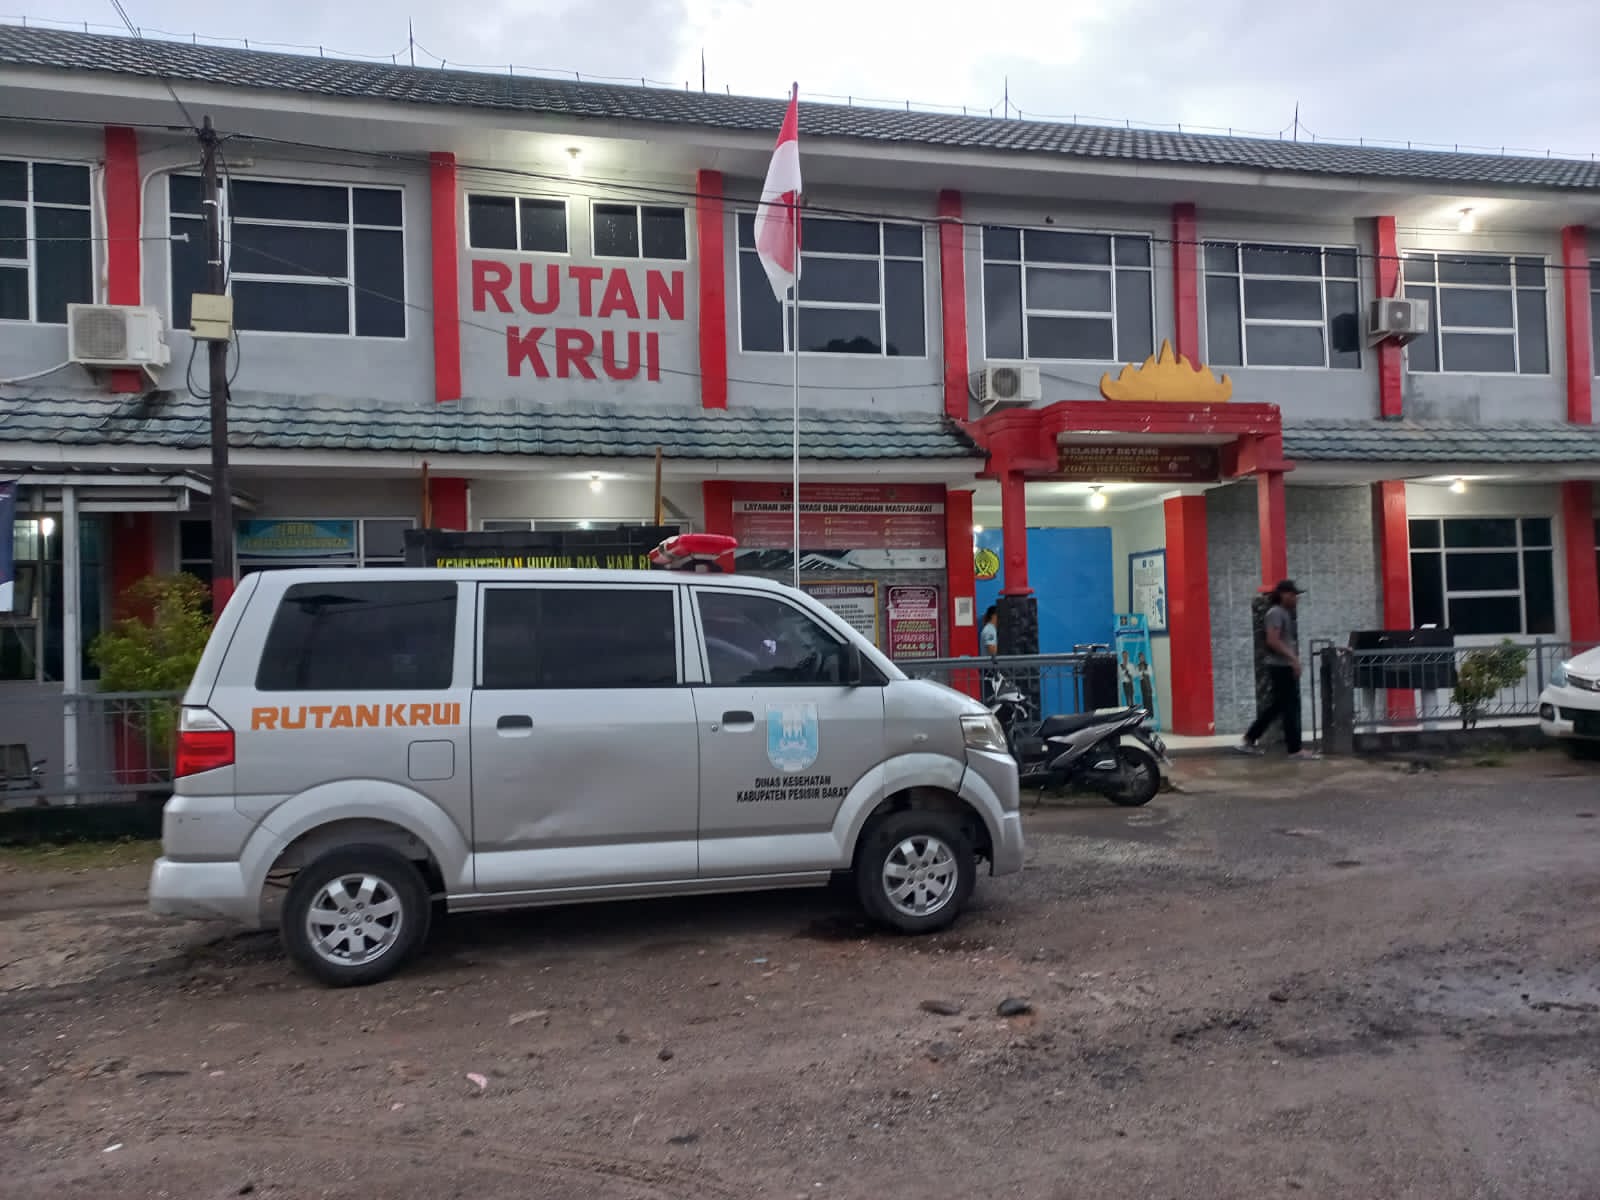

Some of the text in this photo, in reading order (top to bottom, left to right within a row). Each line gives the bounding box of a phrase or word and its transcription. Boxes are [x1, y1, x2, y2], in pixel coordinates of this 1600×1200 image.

[471, 259, 685, 321] RUTAN
[506, 325, 660, 382] KRUI
[743, 503, 778, 512] LAYANAN
[822, 503, 838, 513] DAN
[839, 503, 884, 513] PENGADUAN
[885, 503, 933, 514] MASYARAKAT
[251, 703, 460, 731] RUTAN KRUI
[755, 775, 831, 788] DINAS KESEHATAN
[736, 786, 848, 803] KABUPATEN PESISIR BARAT
